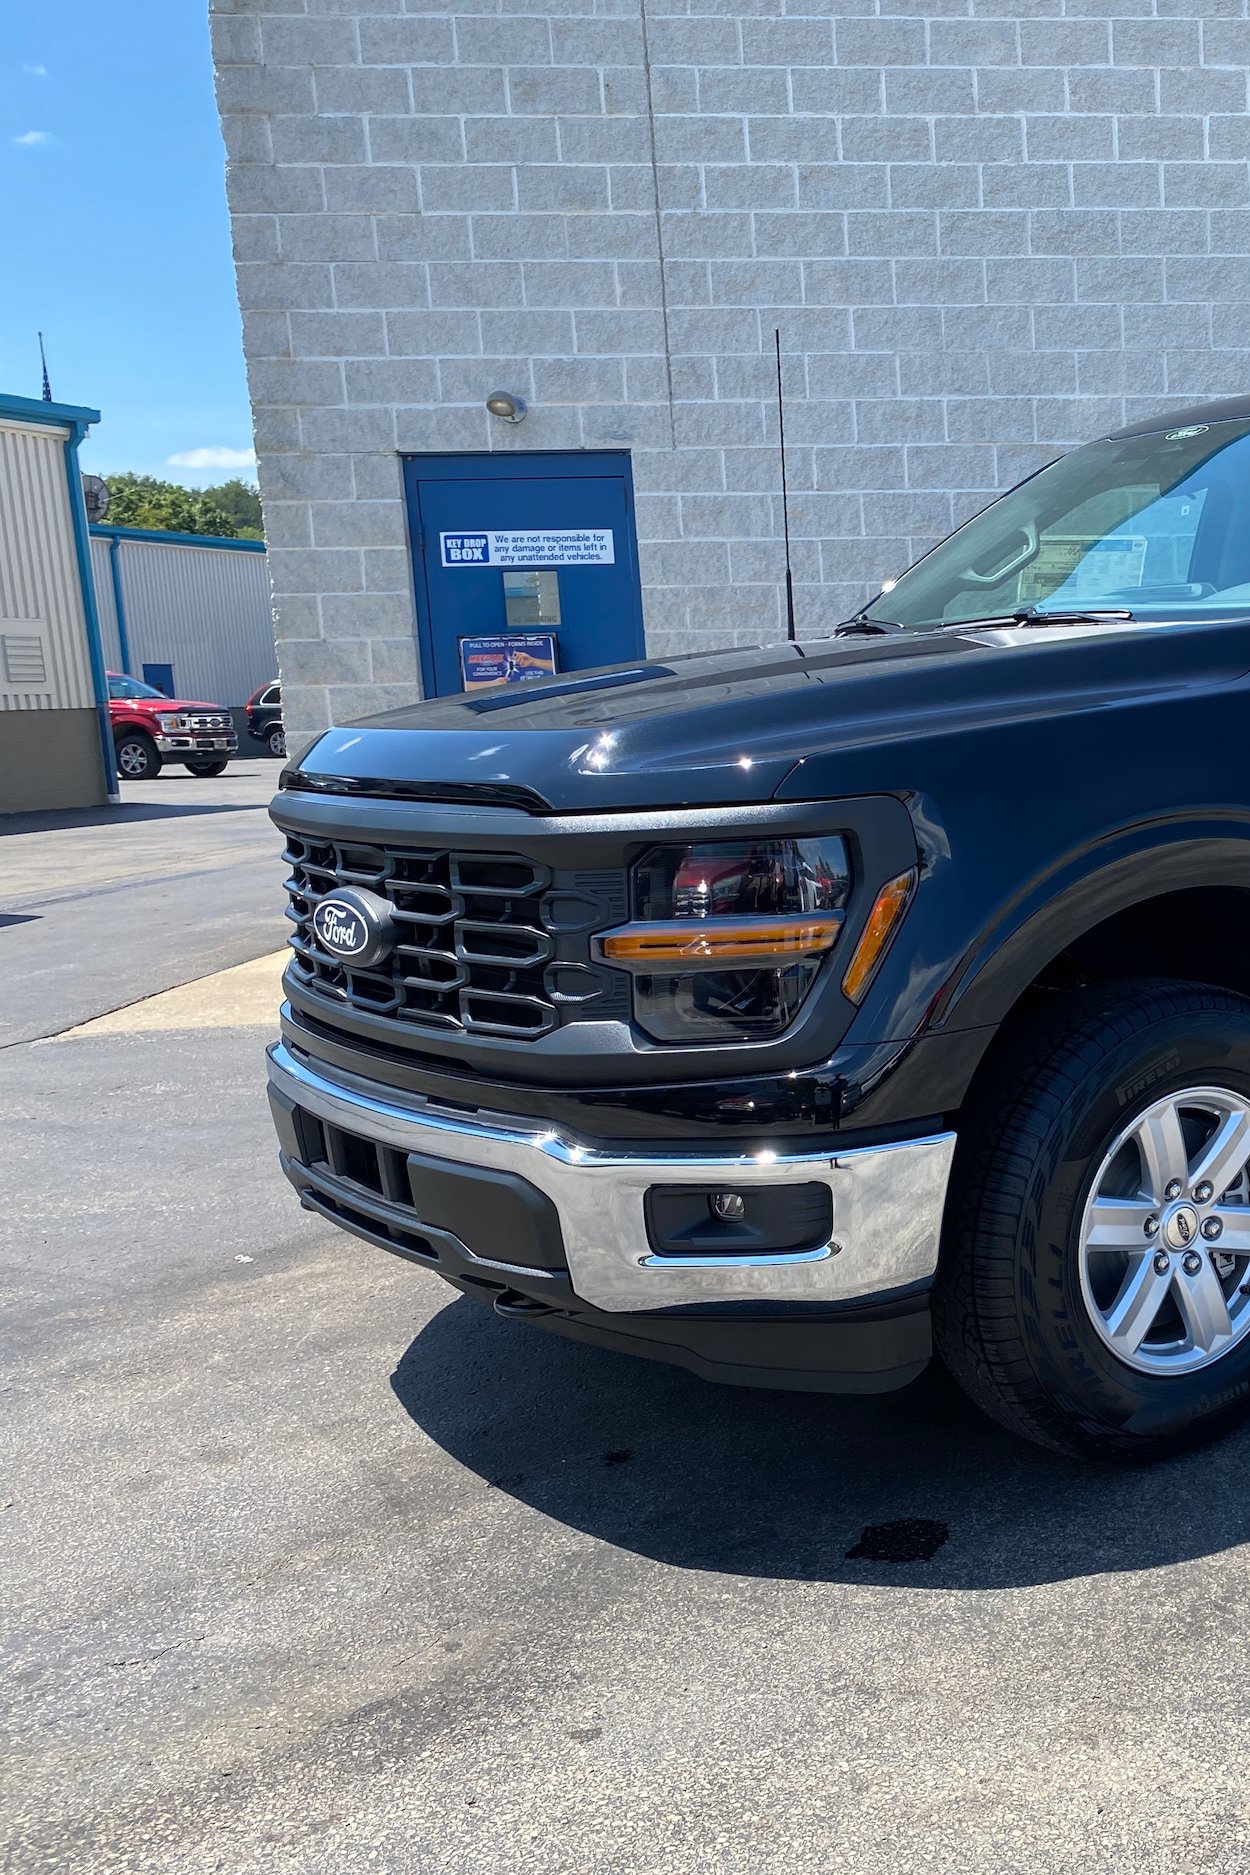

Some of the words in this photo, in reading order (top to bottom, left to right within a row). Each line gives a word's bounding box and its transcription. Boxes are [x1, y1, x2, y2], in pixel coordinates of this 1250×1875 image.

[446, 539, 462, 548] KEY
[463, 538, 487, 548] DROP
[495, 535, 509, 543] We
[543, 533, 590, 544] responsible
[593, 533, 605, 541] for
[512, 544, 545, 553] damage
[558, 543, 582, 551] items
[450, 547, 484, 561] BOX
[500, 555, 515, 563] any
[518, 552, 564, 561] unattended
[567, 551, 602, 560] vehicles.
[323, 906, 357, 947] Ford
